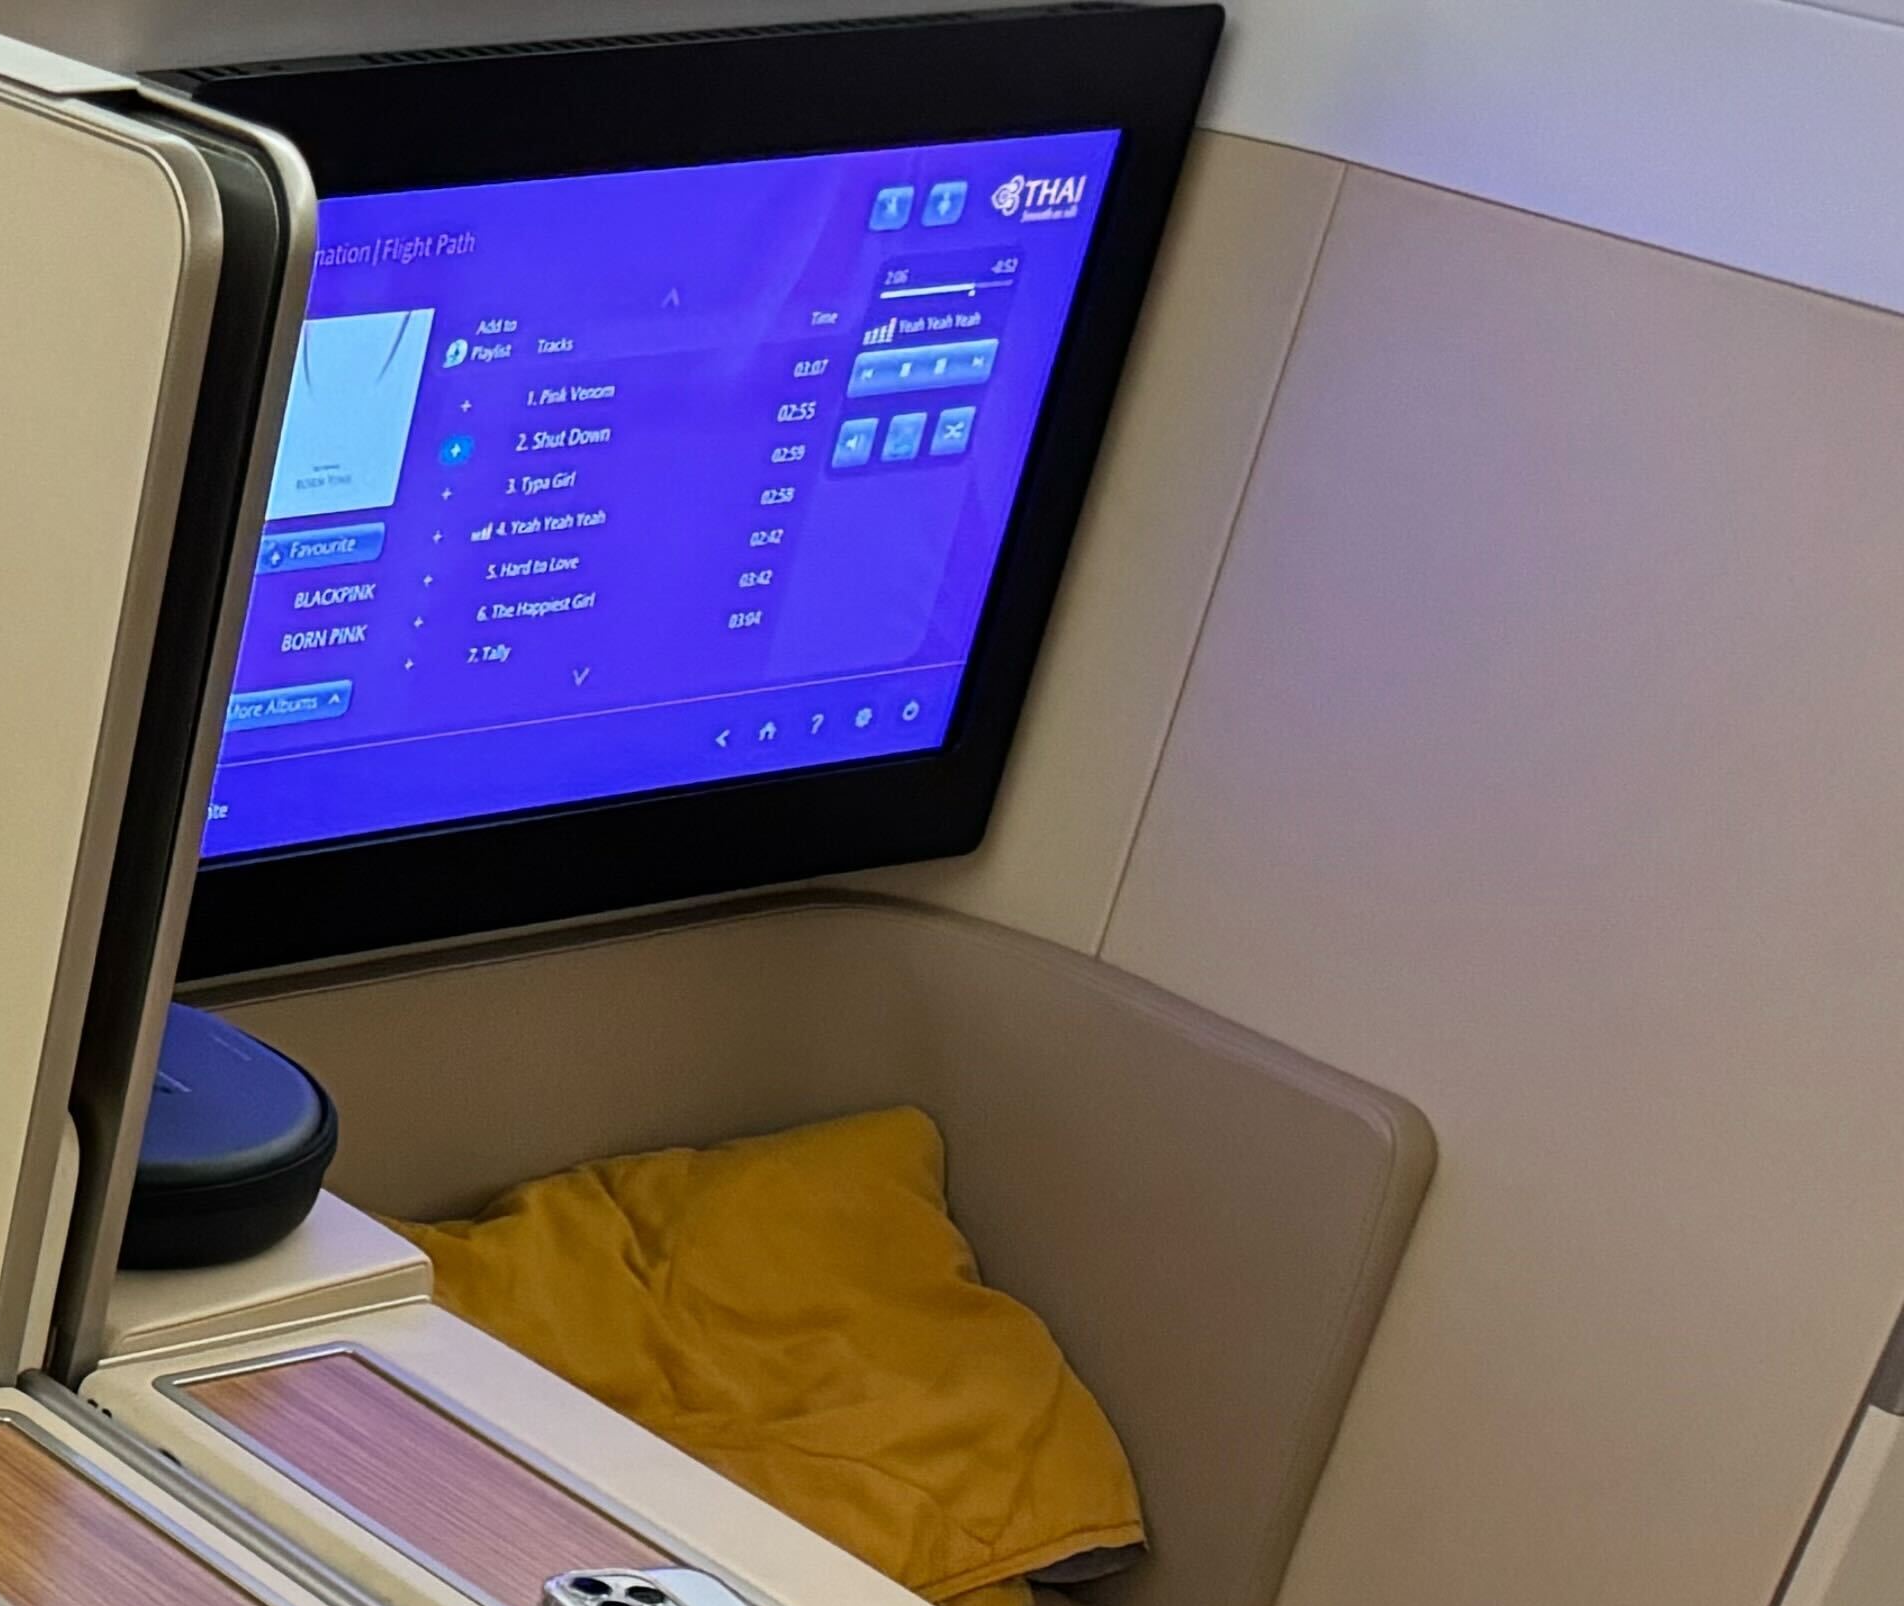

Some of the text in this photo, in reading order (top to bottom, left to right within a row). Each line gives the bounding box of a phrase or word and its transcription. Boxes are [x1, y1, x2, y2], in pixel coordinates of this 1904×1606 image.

[1024, 175, 1087, 207] THAI
[382, 236, 431, 264] Flight
[436, 232, 475, 256] Path
[811, 312, 838, 326] Time
[537, 337, 574, 353] Tracks
[532, 430, 566, 451] Shut
[569, 427, 611, 448] Down
[511, 518, 541, 536] Yeah
[543, 514, 574, 532] Yeah
[576, 510, 606, 528] Yeah
[291, 536, 357, 559] Favourite
[500, 560, 531, 578] Hard
[548, 556, 580, 573] Love
[294, 583, 376, 608] BLACKPINK
[281, 625, 367, 653] BORN PINK
